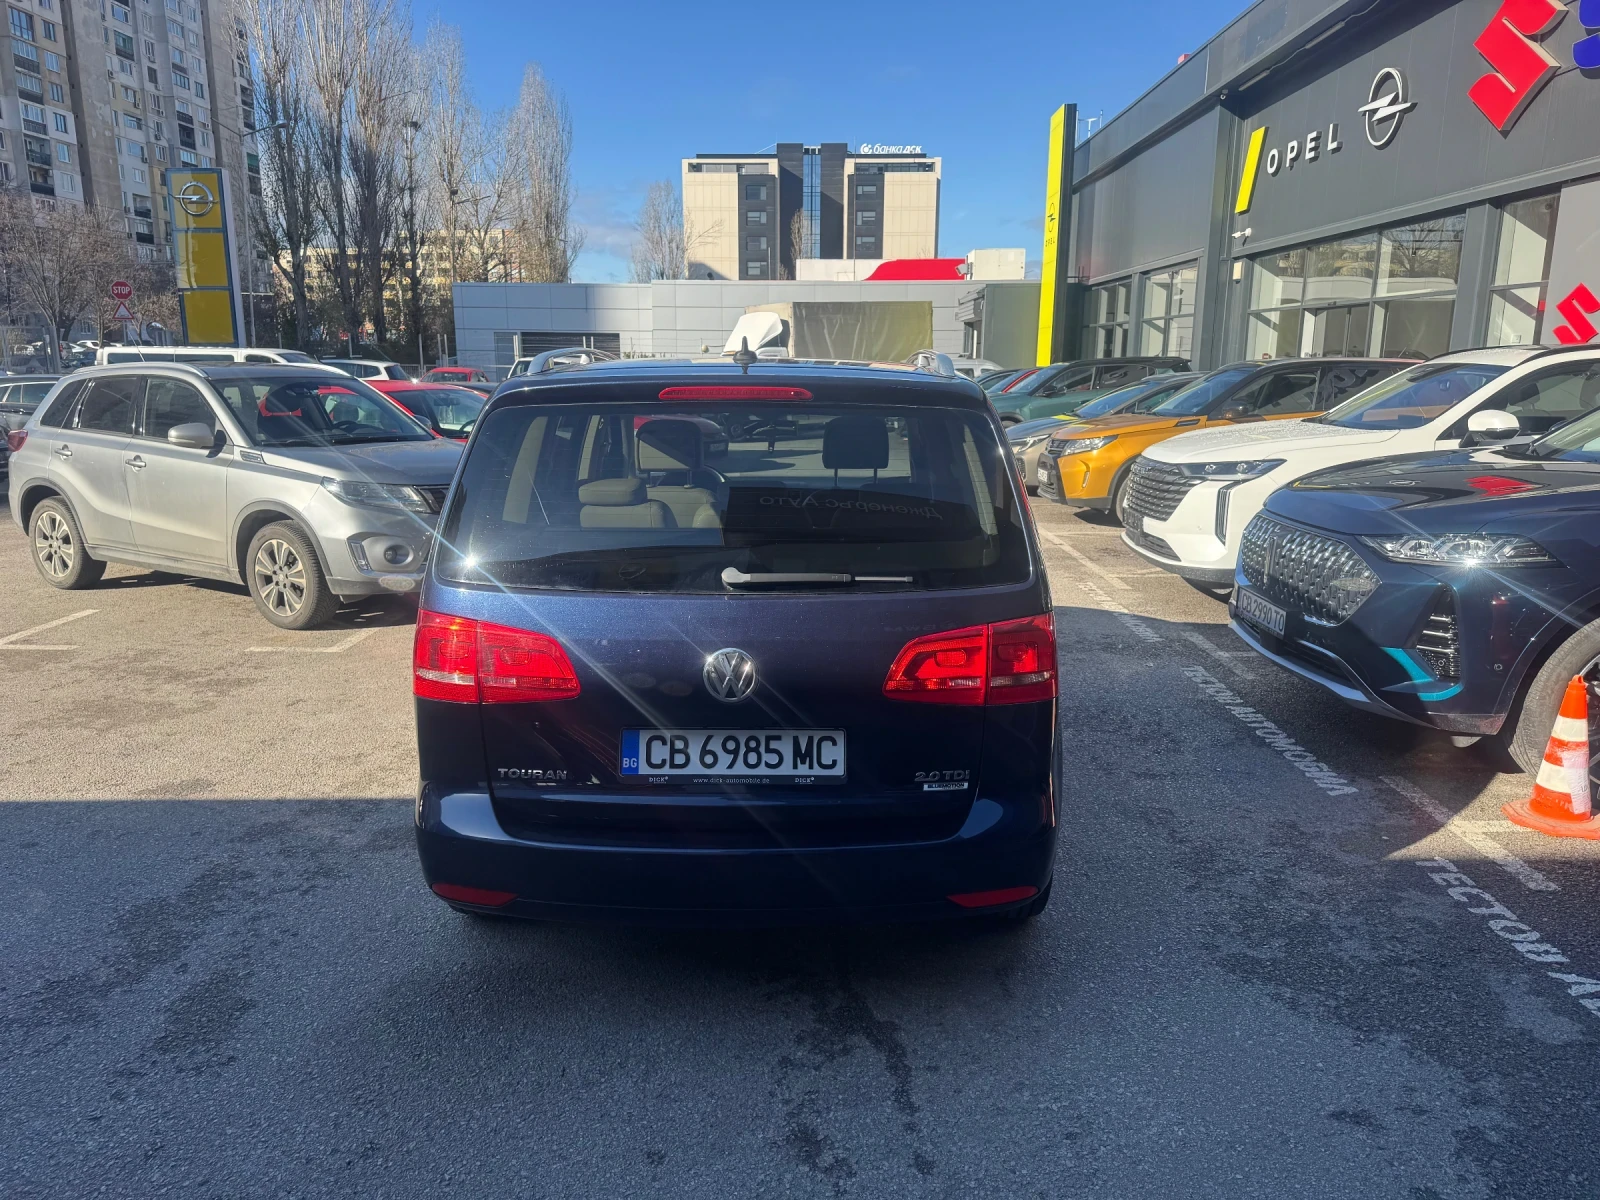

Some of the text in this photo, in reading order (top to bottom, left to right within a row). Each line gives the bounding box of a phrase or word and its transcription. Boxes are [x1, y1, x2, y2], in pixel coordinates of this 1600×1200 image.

[873, 138, 903, 154] банка
[1267, 123, 1339, 175] OPEL
[113, 286, 130, 295] STOP
[645, 734, 838, 770] CB 6985 MC
[622, 757, 638, 769] BG
[497, 768, 567, 780] TOURAN
[693, 776, 770, 784] www.dick-automobile.de
[942, 769, 971, 780] TDI
